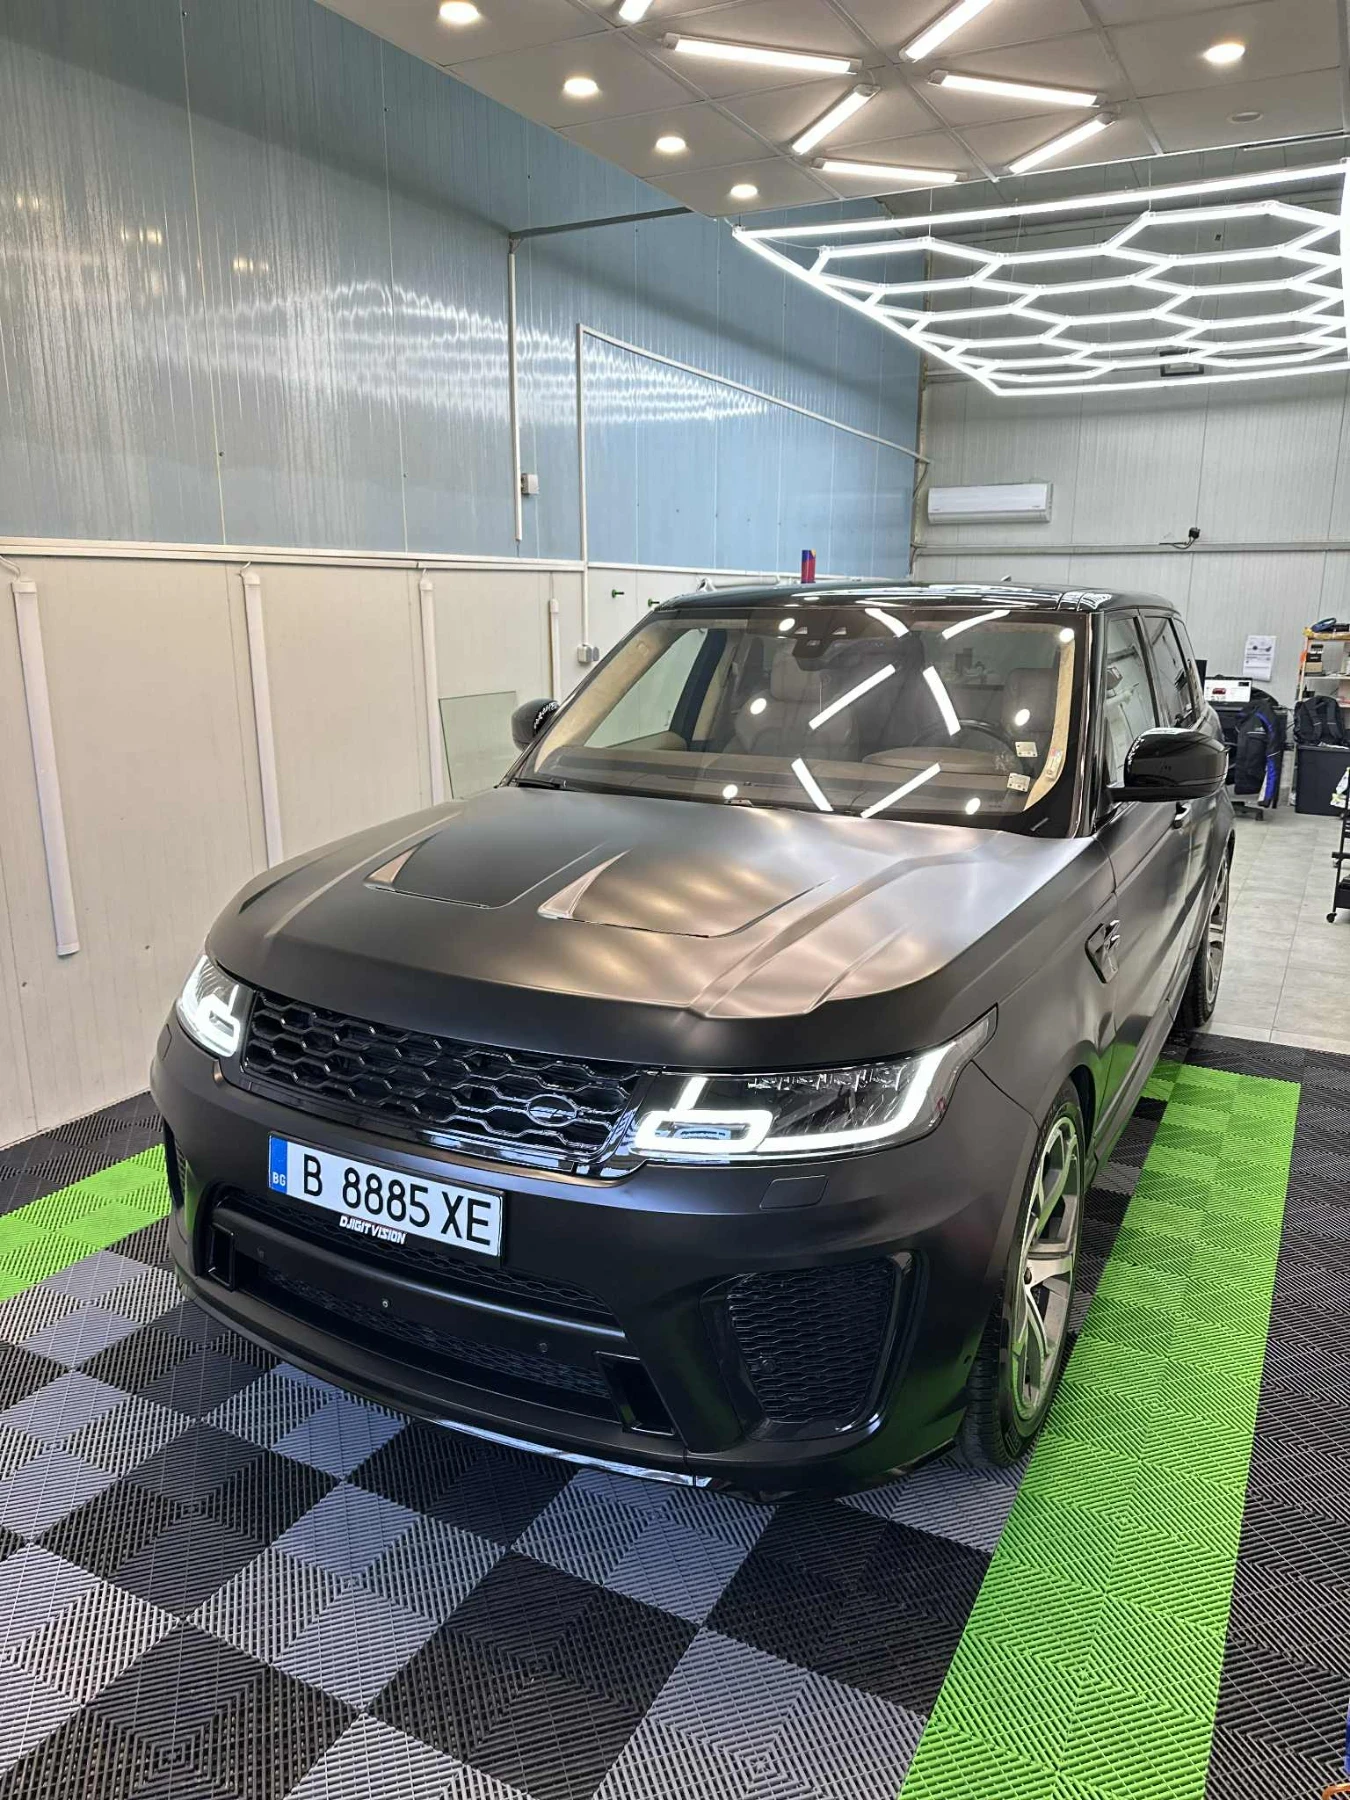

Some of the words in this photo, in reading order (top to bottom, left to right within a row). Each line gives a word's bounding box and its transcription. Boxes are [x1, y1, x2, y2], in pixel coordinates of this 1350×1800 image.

[272, 1171, 286, 1187] BG
[303, 1153, 323, 1197] B
[342, 1167, 430, 1227] 8885
[441, 1190, 491, 1246] XE
